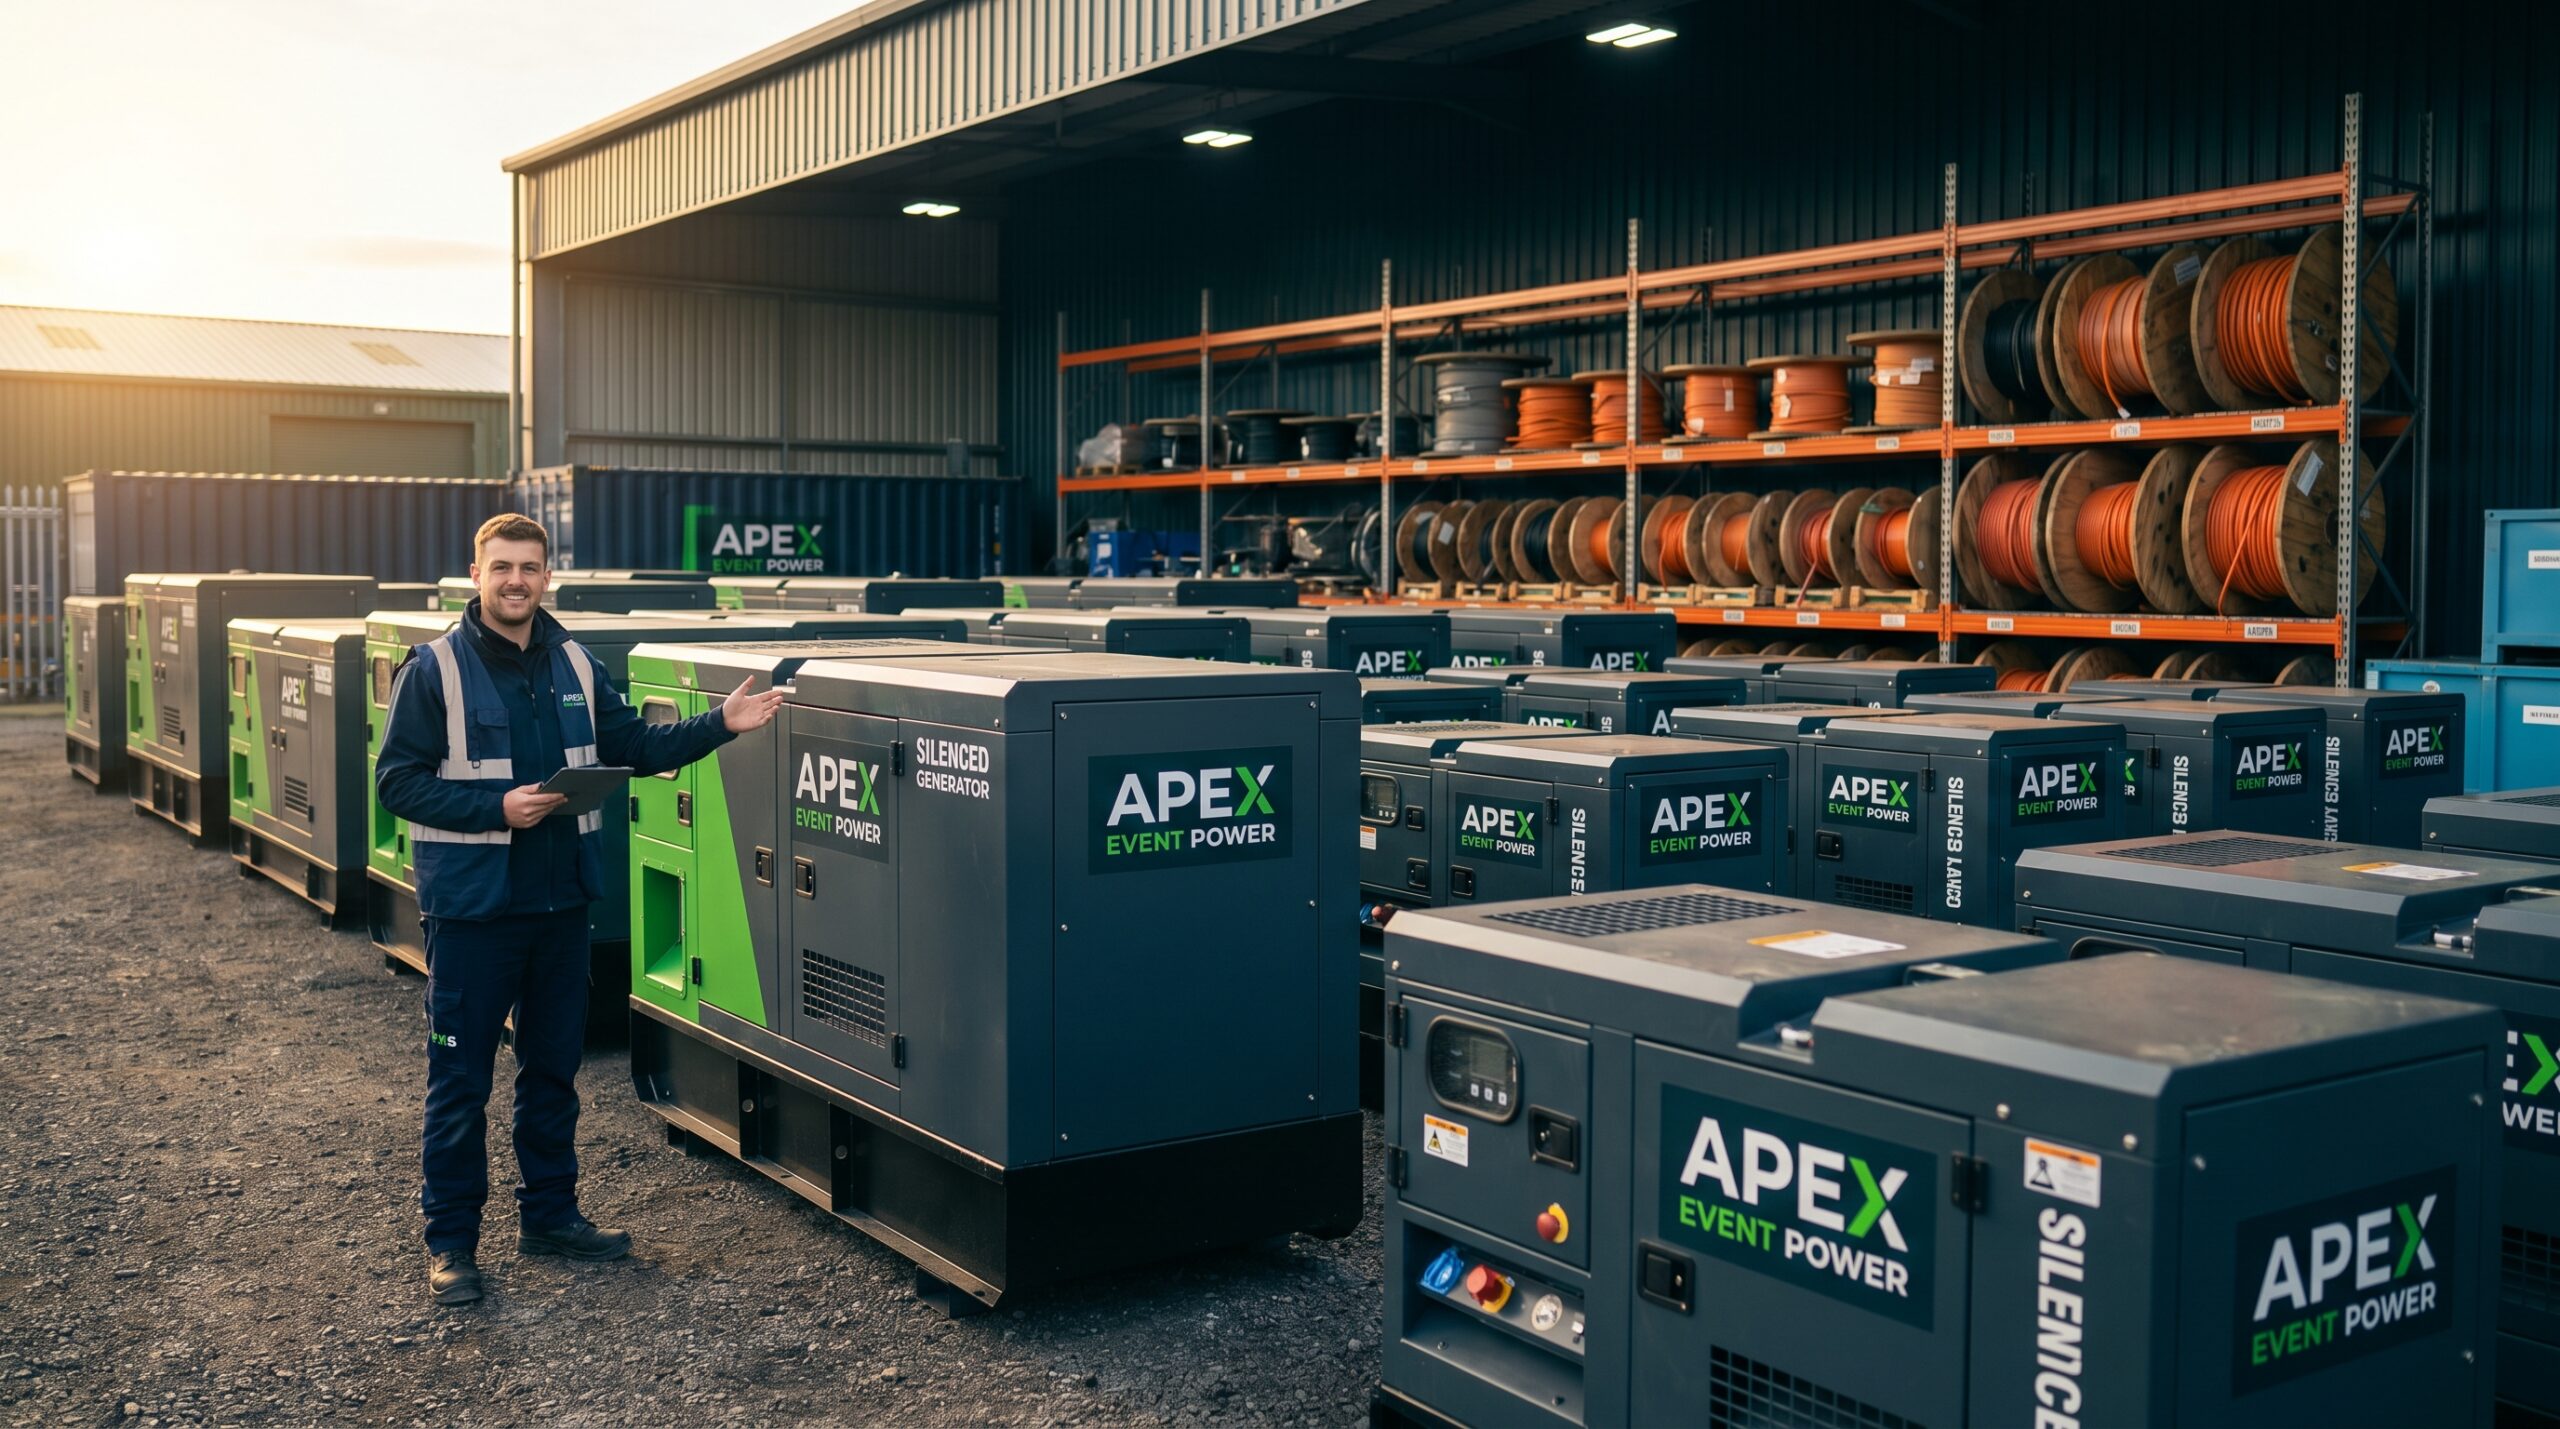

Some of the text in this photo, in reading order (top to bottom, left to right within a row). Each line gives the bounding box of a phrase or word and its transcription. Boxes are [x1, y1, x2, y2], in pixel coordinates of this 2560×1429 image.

[712, 523, 823, 555] APEX
[713, 558, 824, 573] EVENT POWER
[1354, 650, 1422, 674] APEX
[1589, 652, 1650, 673] APEX
[916, 737, 990, 773] SILENCED
[2386, 725, 2444, 756] APEX
[2236, 743, 2302, 775] APEX
[2385, 754, 2444, 770] EVENT POWER
[795, 752, 880, 816] APEX
[916, 769, 990, 800] GENERATOR
[1106, 765, 1276, 827] APEX
[1829, 775, 1910, 808] APEX
[2018, 761, 2097, 800] APEX
[2236, 773, 2302, 791] EVENT POWER
[1651, 791, 1752, 835] APEX
[1828, 803, 1910, 823] EVENT POWER
[2018, 796, 2098, 816] EVENT POWER
[795, 807, 881, 845] EVENT POWER
[1461, 804, 1536, 841] APEX
[1106, 823, 1276, 856] EVENT POWER
[1461, 834, 1536, 857] EVENT POWER
[1650, 831, 1752, 854] EVENT POWER
[1680, 1116, 1909, 1253] APEX
[1680, 1194, 1909, 1298] EVENT POWER
[2253, 1194, 2437, 1322] APEX
[2253, 1281, 2437, 1366] EVENT POWER
